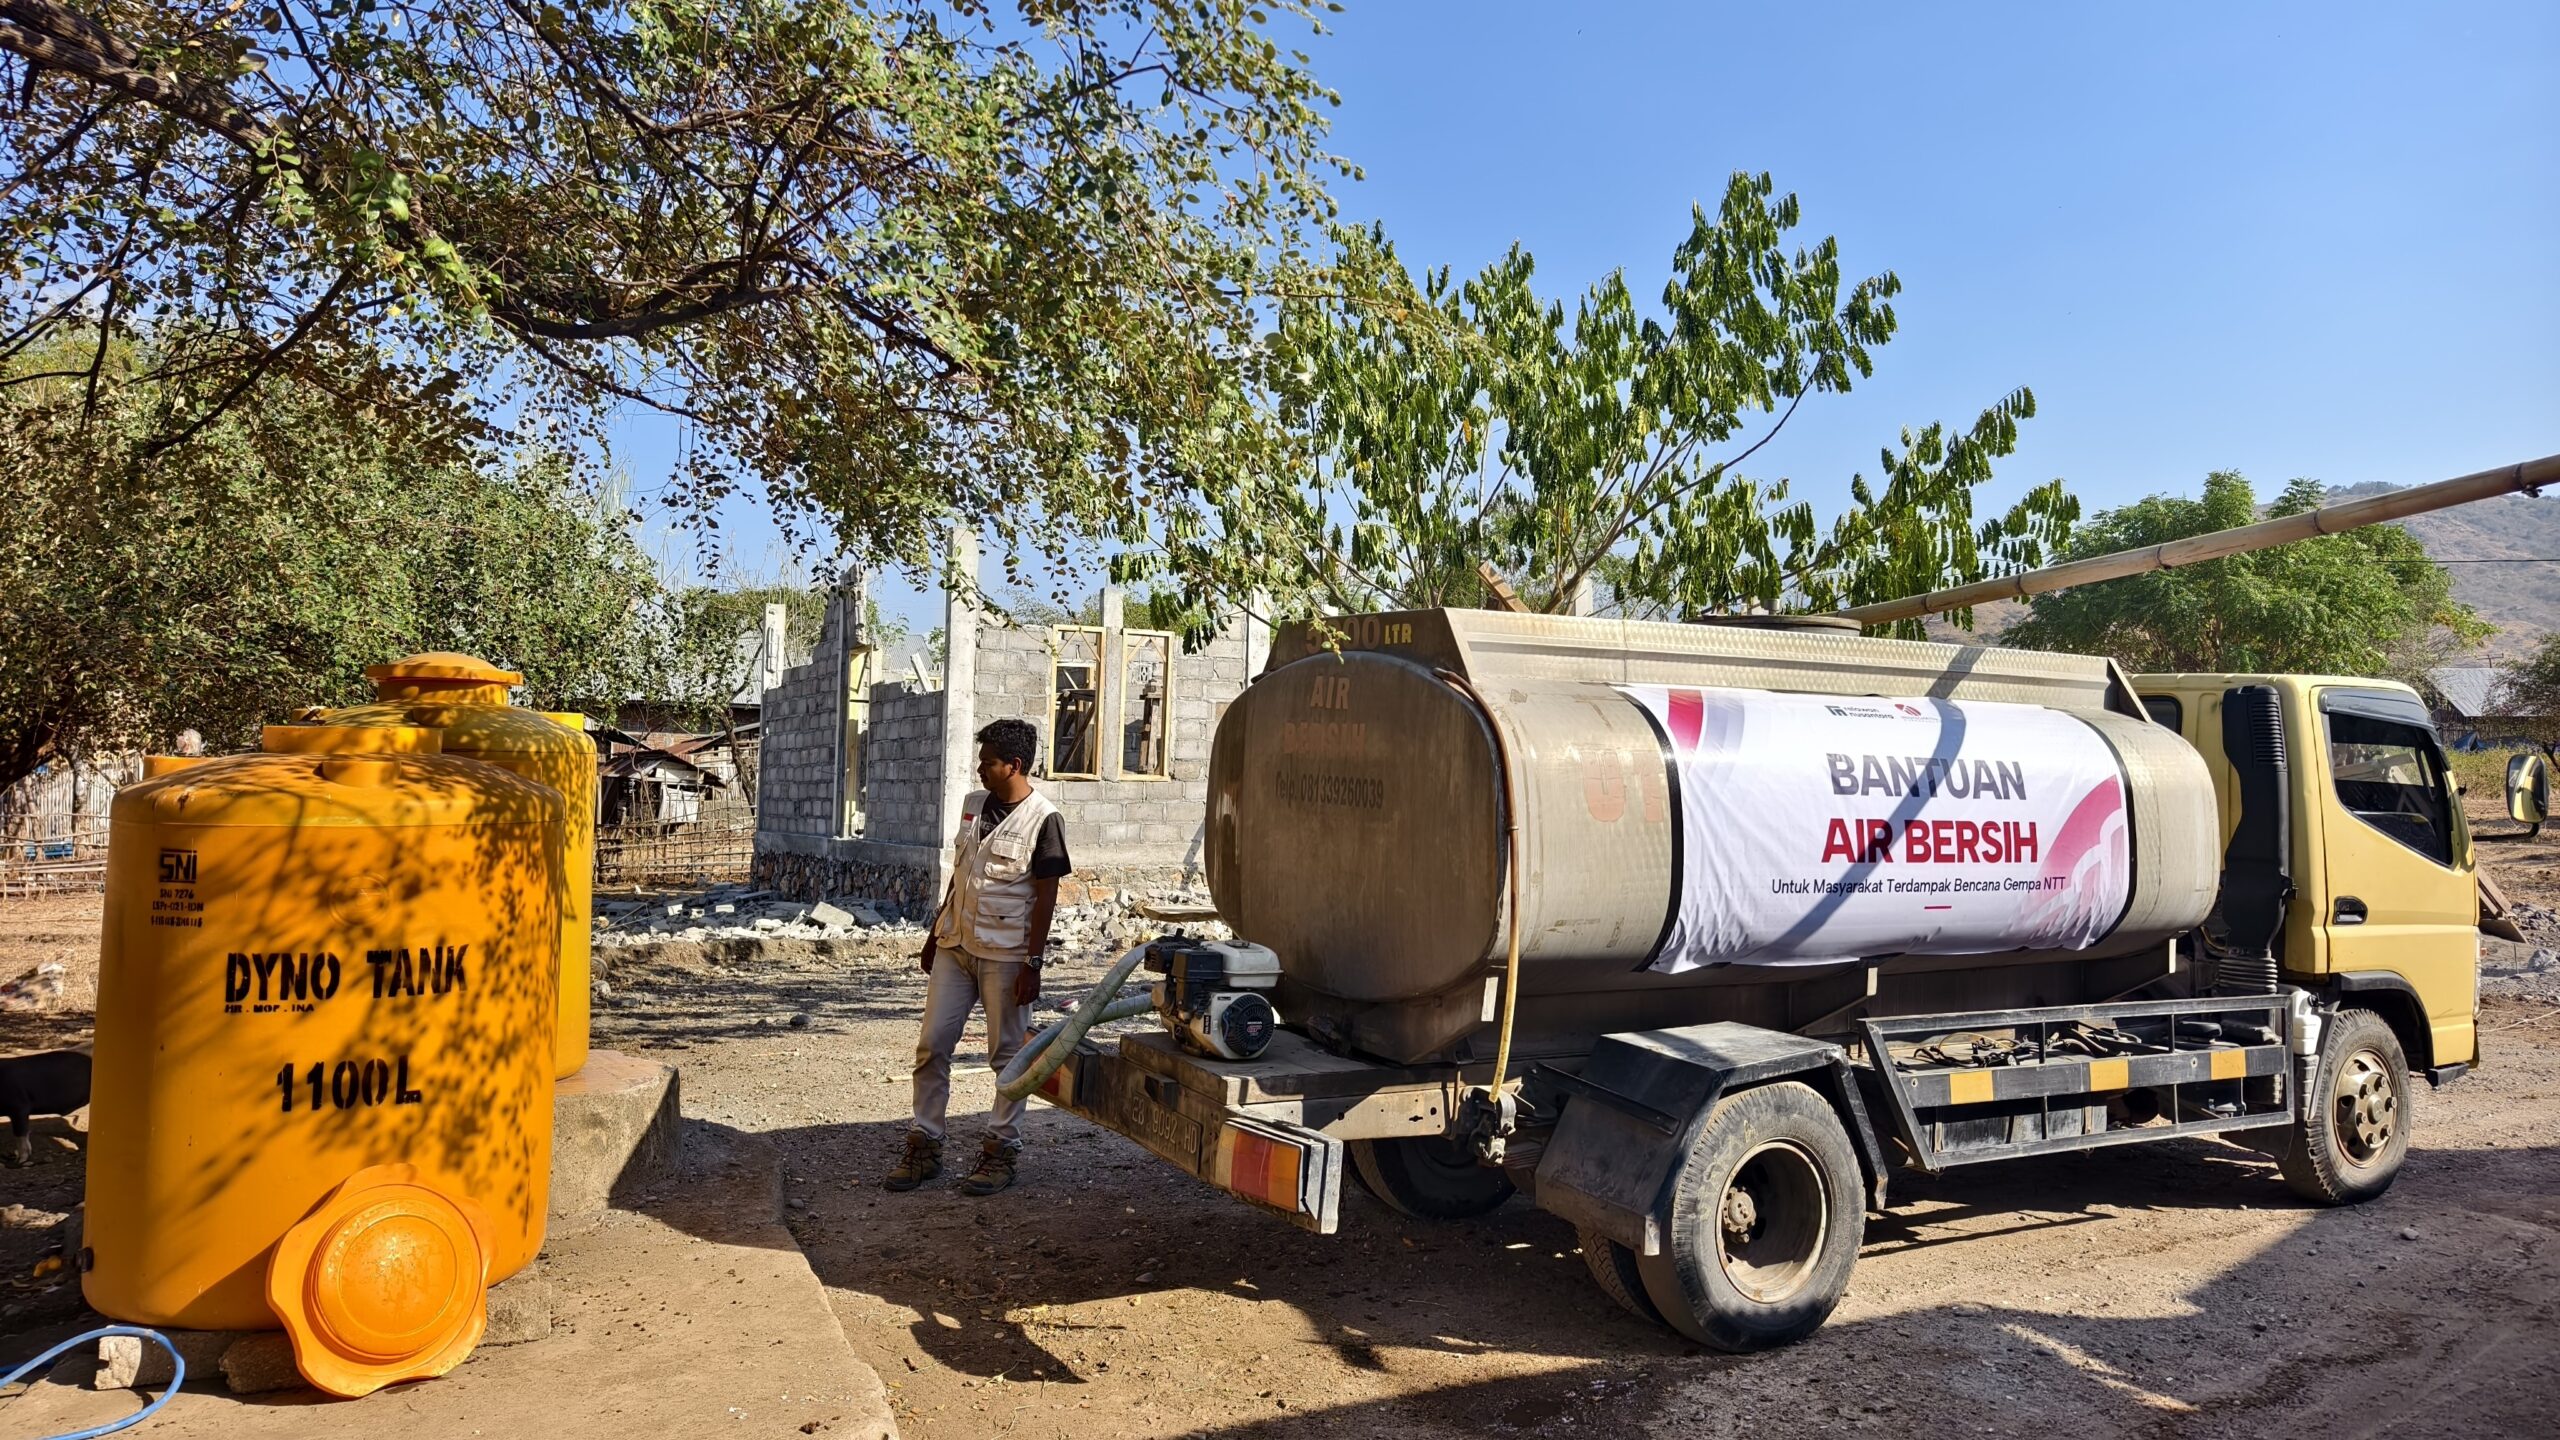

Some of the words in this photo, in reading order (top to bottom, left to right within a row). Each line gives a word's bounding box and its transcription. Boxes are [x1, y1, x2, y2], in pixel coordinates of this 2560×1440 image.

[1305, 615, 1381, 654] 500
[1384, 622, 1413, 645] LTR
[1310, 675, 1350, 710] AIR
[1826, 753, 2027, 801] BANTUAN
[1821, 818, 1894, 864] AIR
[1904, 819, 2038, 864] BERSIH
[159, 850, 197, 883] SNI
[1772, 878, 1810, 894] Untuk
[1813, 877, 1883, 897] Masyarakat
[1887, 878, 1952, 896] Terdampak
[1954, 877, 2001, 893] Bencana
[2003, 876, 2042, 894] Gempa
[2043, 876, 2067, 891] NTT
[225, 951, 341, 1003] DYNO
[366, 943, 470, 999] TANK
[291, 1003, 315, 1013] INA
[277, 1055, 422, 1113] 1100L
[1152, 1107, 1178, 1145] 9092
